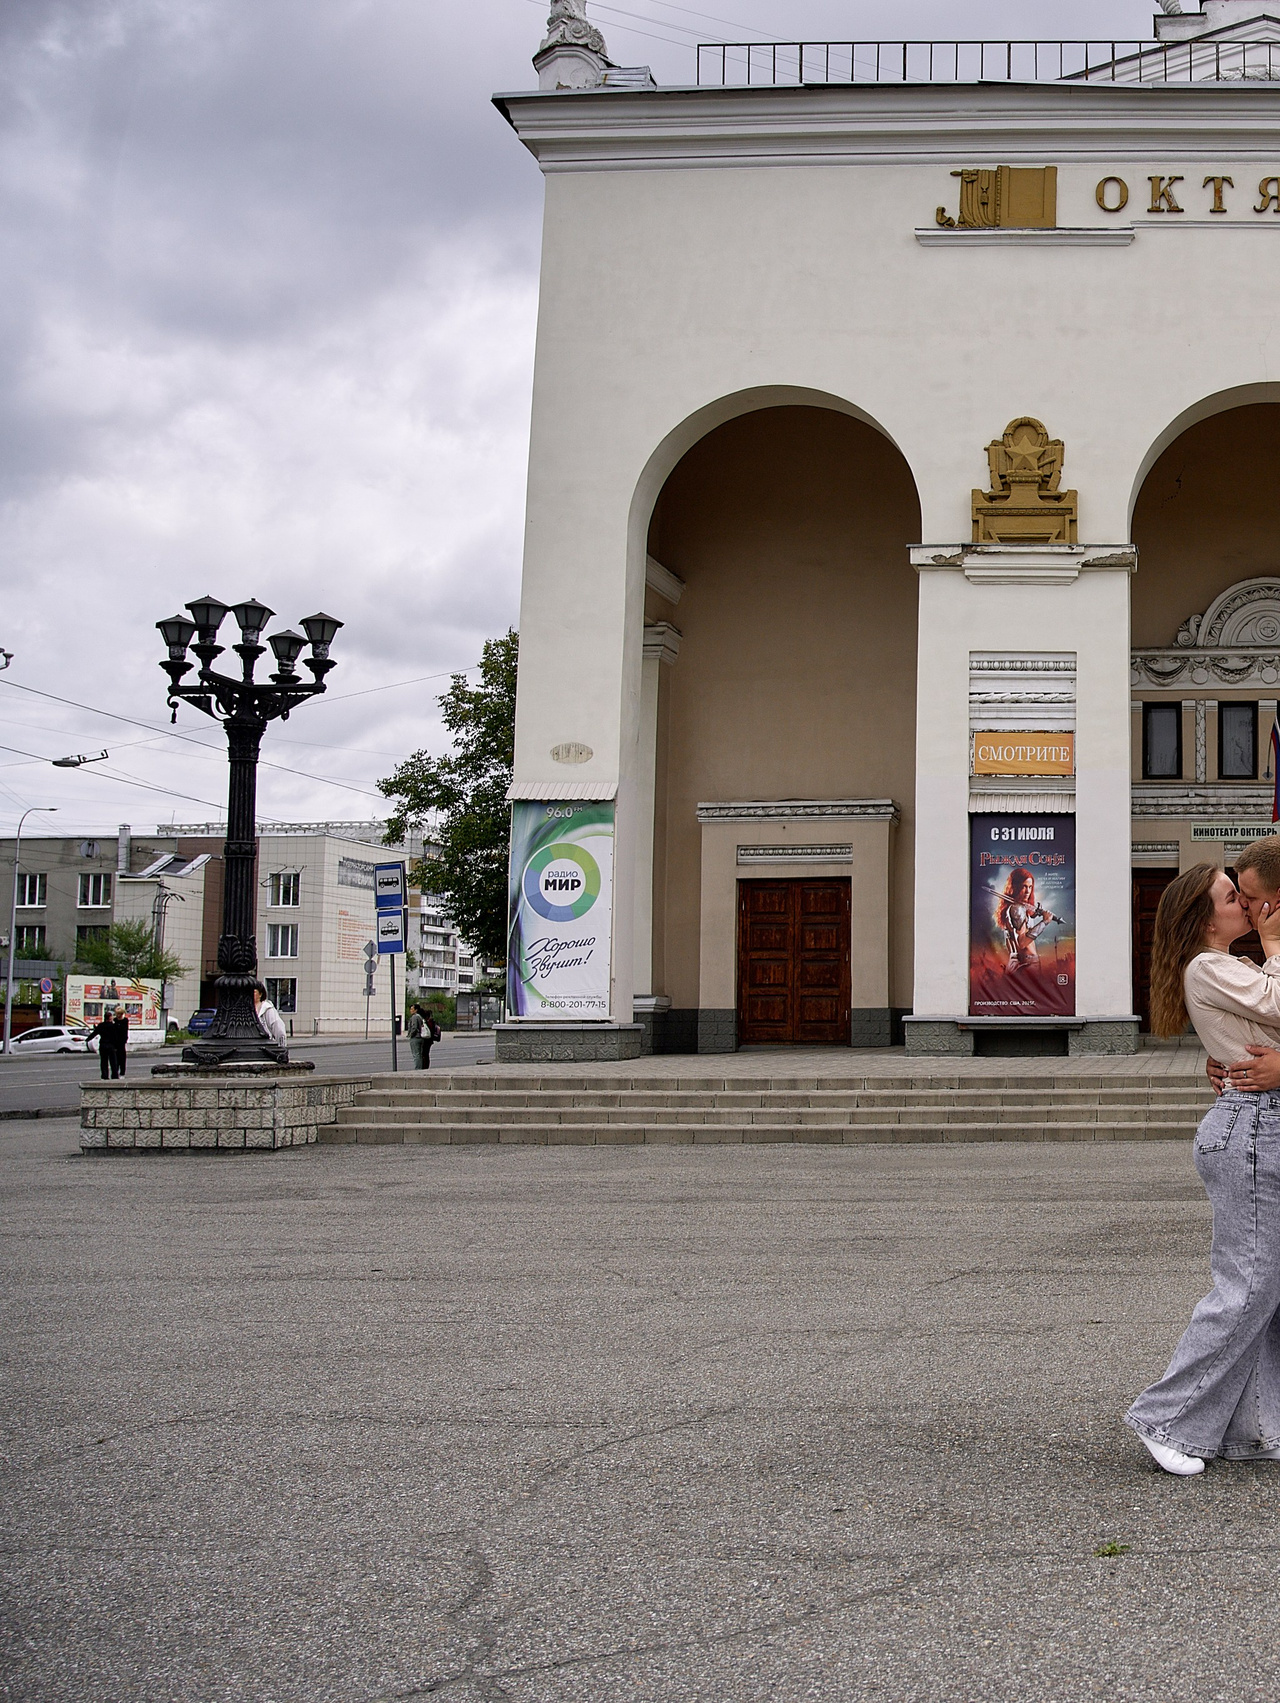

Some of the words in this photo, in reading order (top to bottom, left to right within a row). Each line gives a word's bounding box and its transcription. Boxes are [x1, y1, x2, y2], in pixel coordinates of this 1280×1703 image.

[978, 745, 1070, 762] СМОТРИТЕ
[546, 806, 573, 818] 96.0
[991, 827, 999, 841] С
[1001, 827, 1015, 841] 31
[1017, 827, 1054, 841] ИЮЛЯ
[1193, 827, 1239, 837] КИНОТЕАТР
[1240, 827, 1277, 837] ОКТЯБРЬ
[547, 870, 579, 879] радио
[544, 879, 582, 891] МИР
[525, 937, 596, 962] Хорошо
[522, 949, 594, 984] Звучит!
[540, 1000, 606, 1009] 8-800-201-77-15
